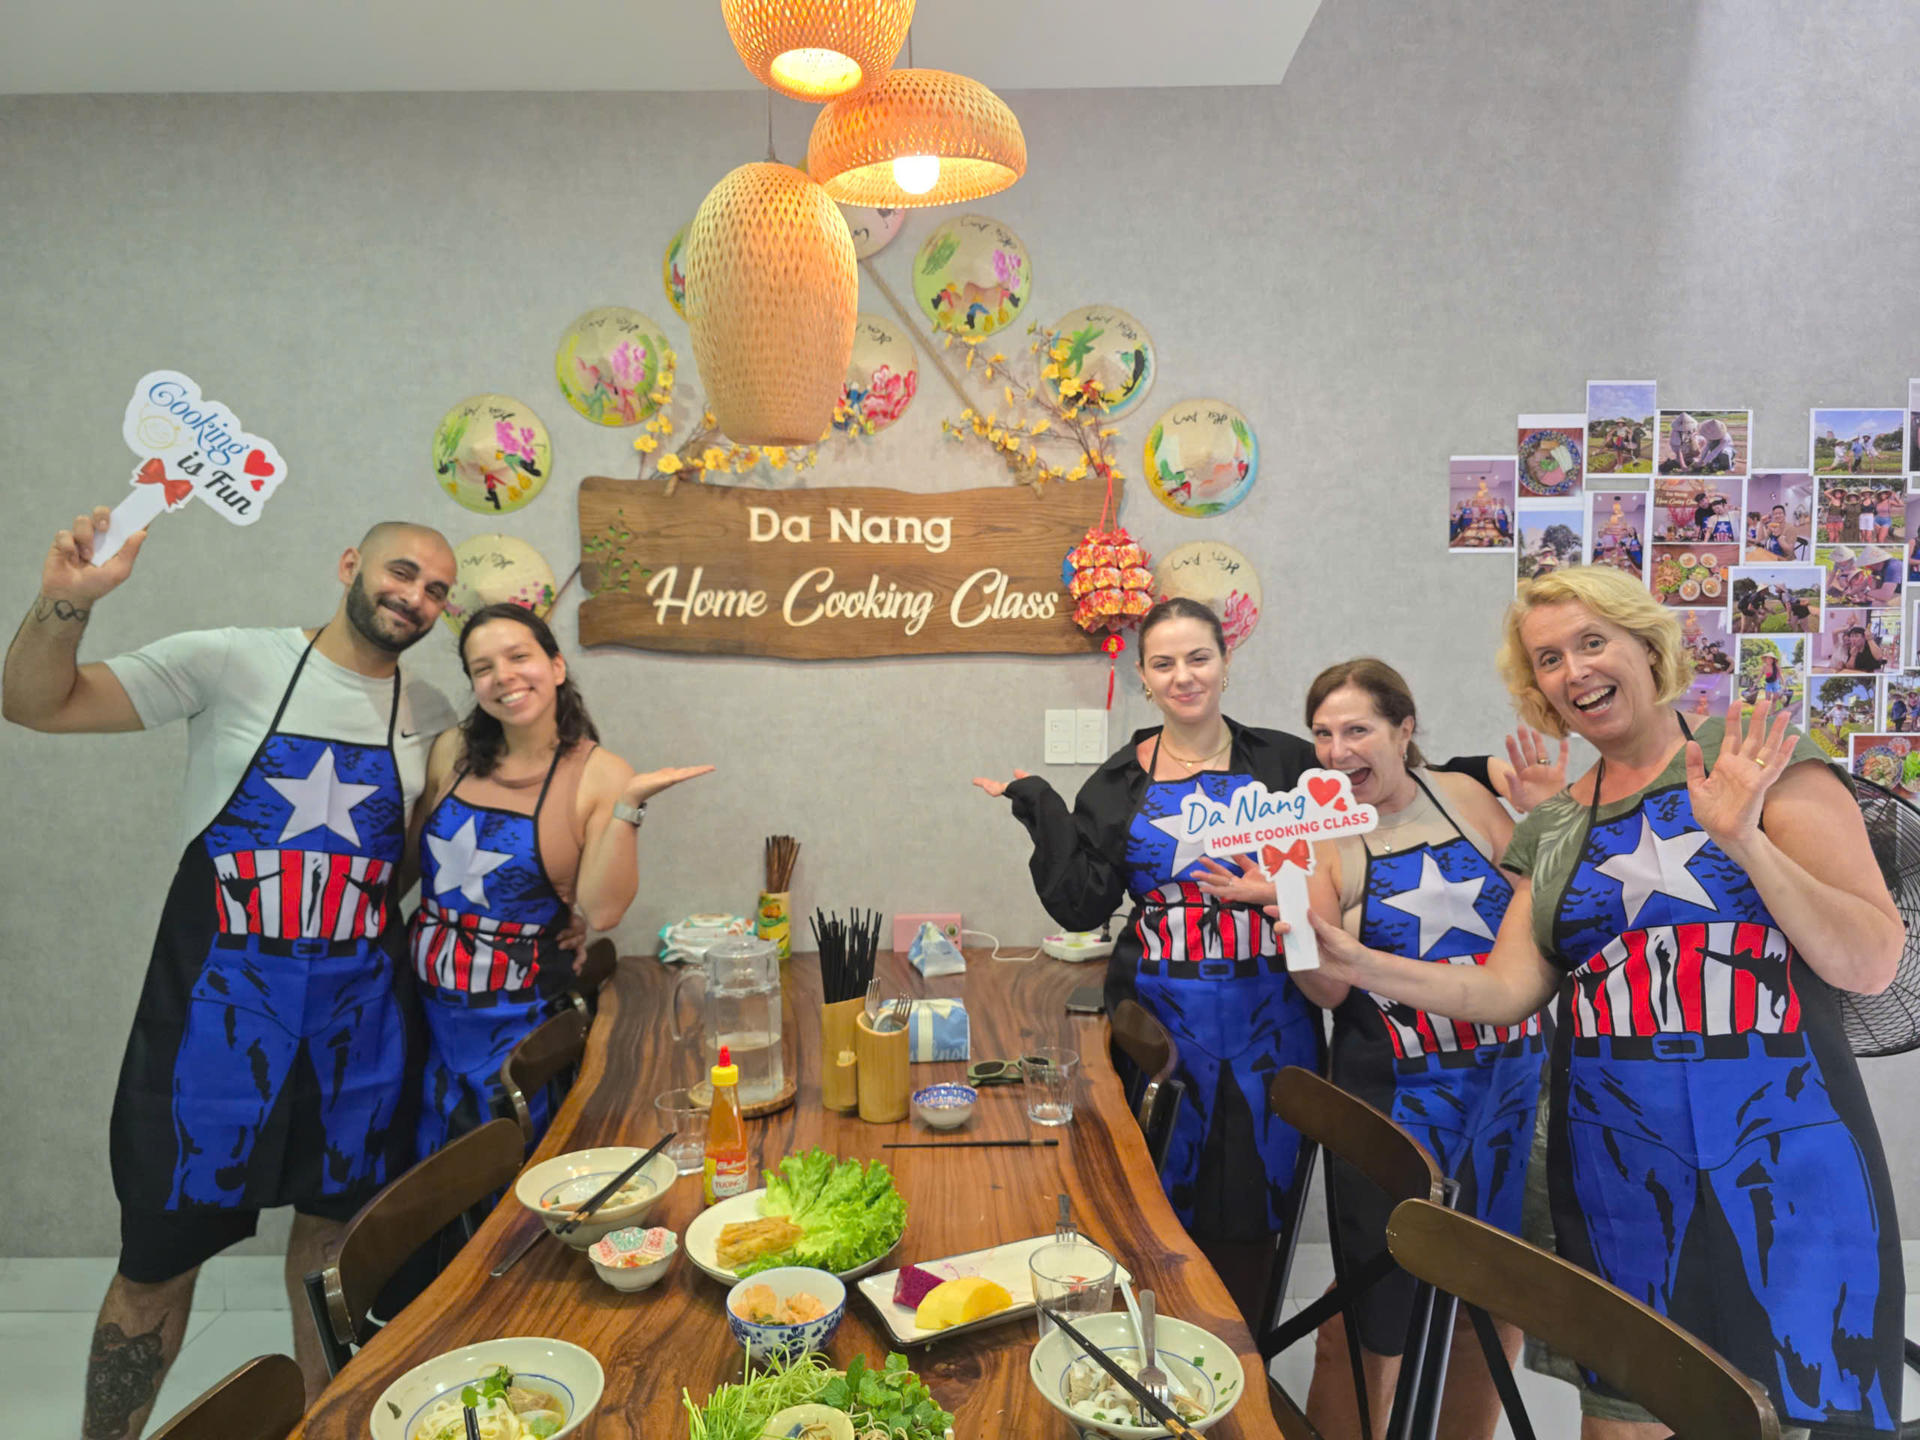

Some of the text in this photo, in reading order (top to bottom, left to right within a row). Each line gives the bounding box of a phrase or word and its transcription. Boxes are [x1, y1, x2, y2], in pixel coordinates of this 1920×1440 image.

[149, 381, 250, 466] Cooking
[177, 451, 253, 516] is Fun
[747, 506, 952, 553] Da Nang
[646, 565, 1059, 636] Home Cooking Class
[1187, 790, 1306, 835] Da Nang
[1211, 812, 1369, 849] HOME COOKING CLASS
